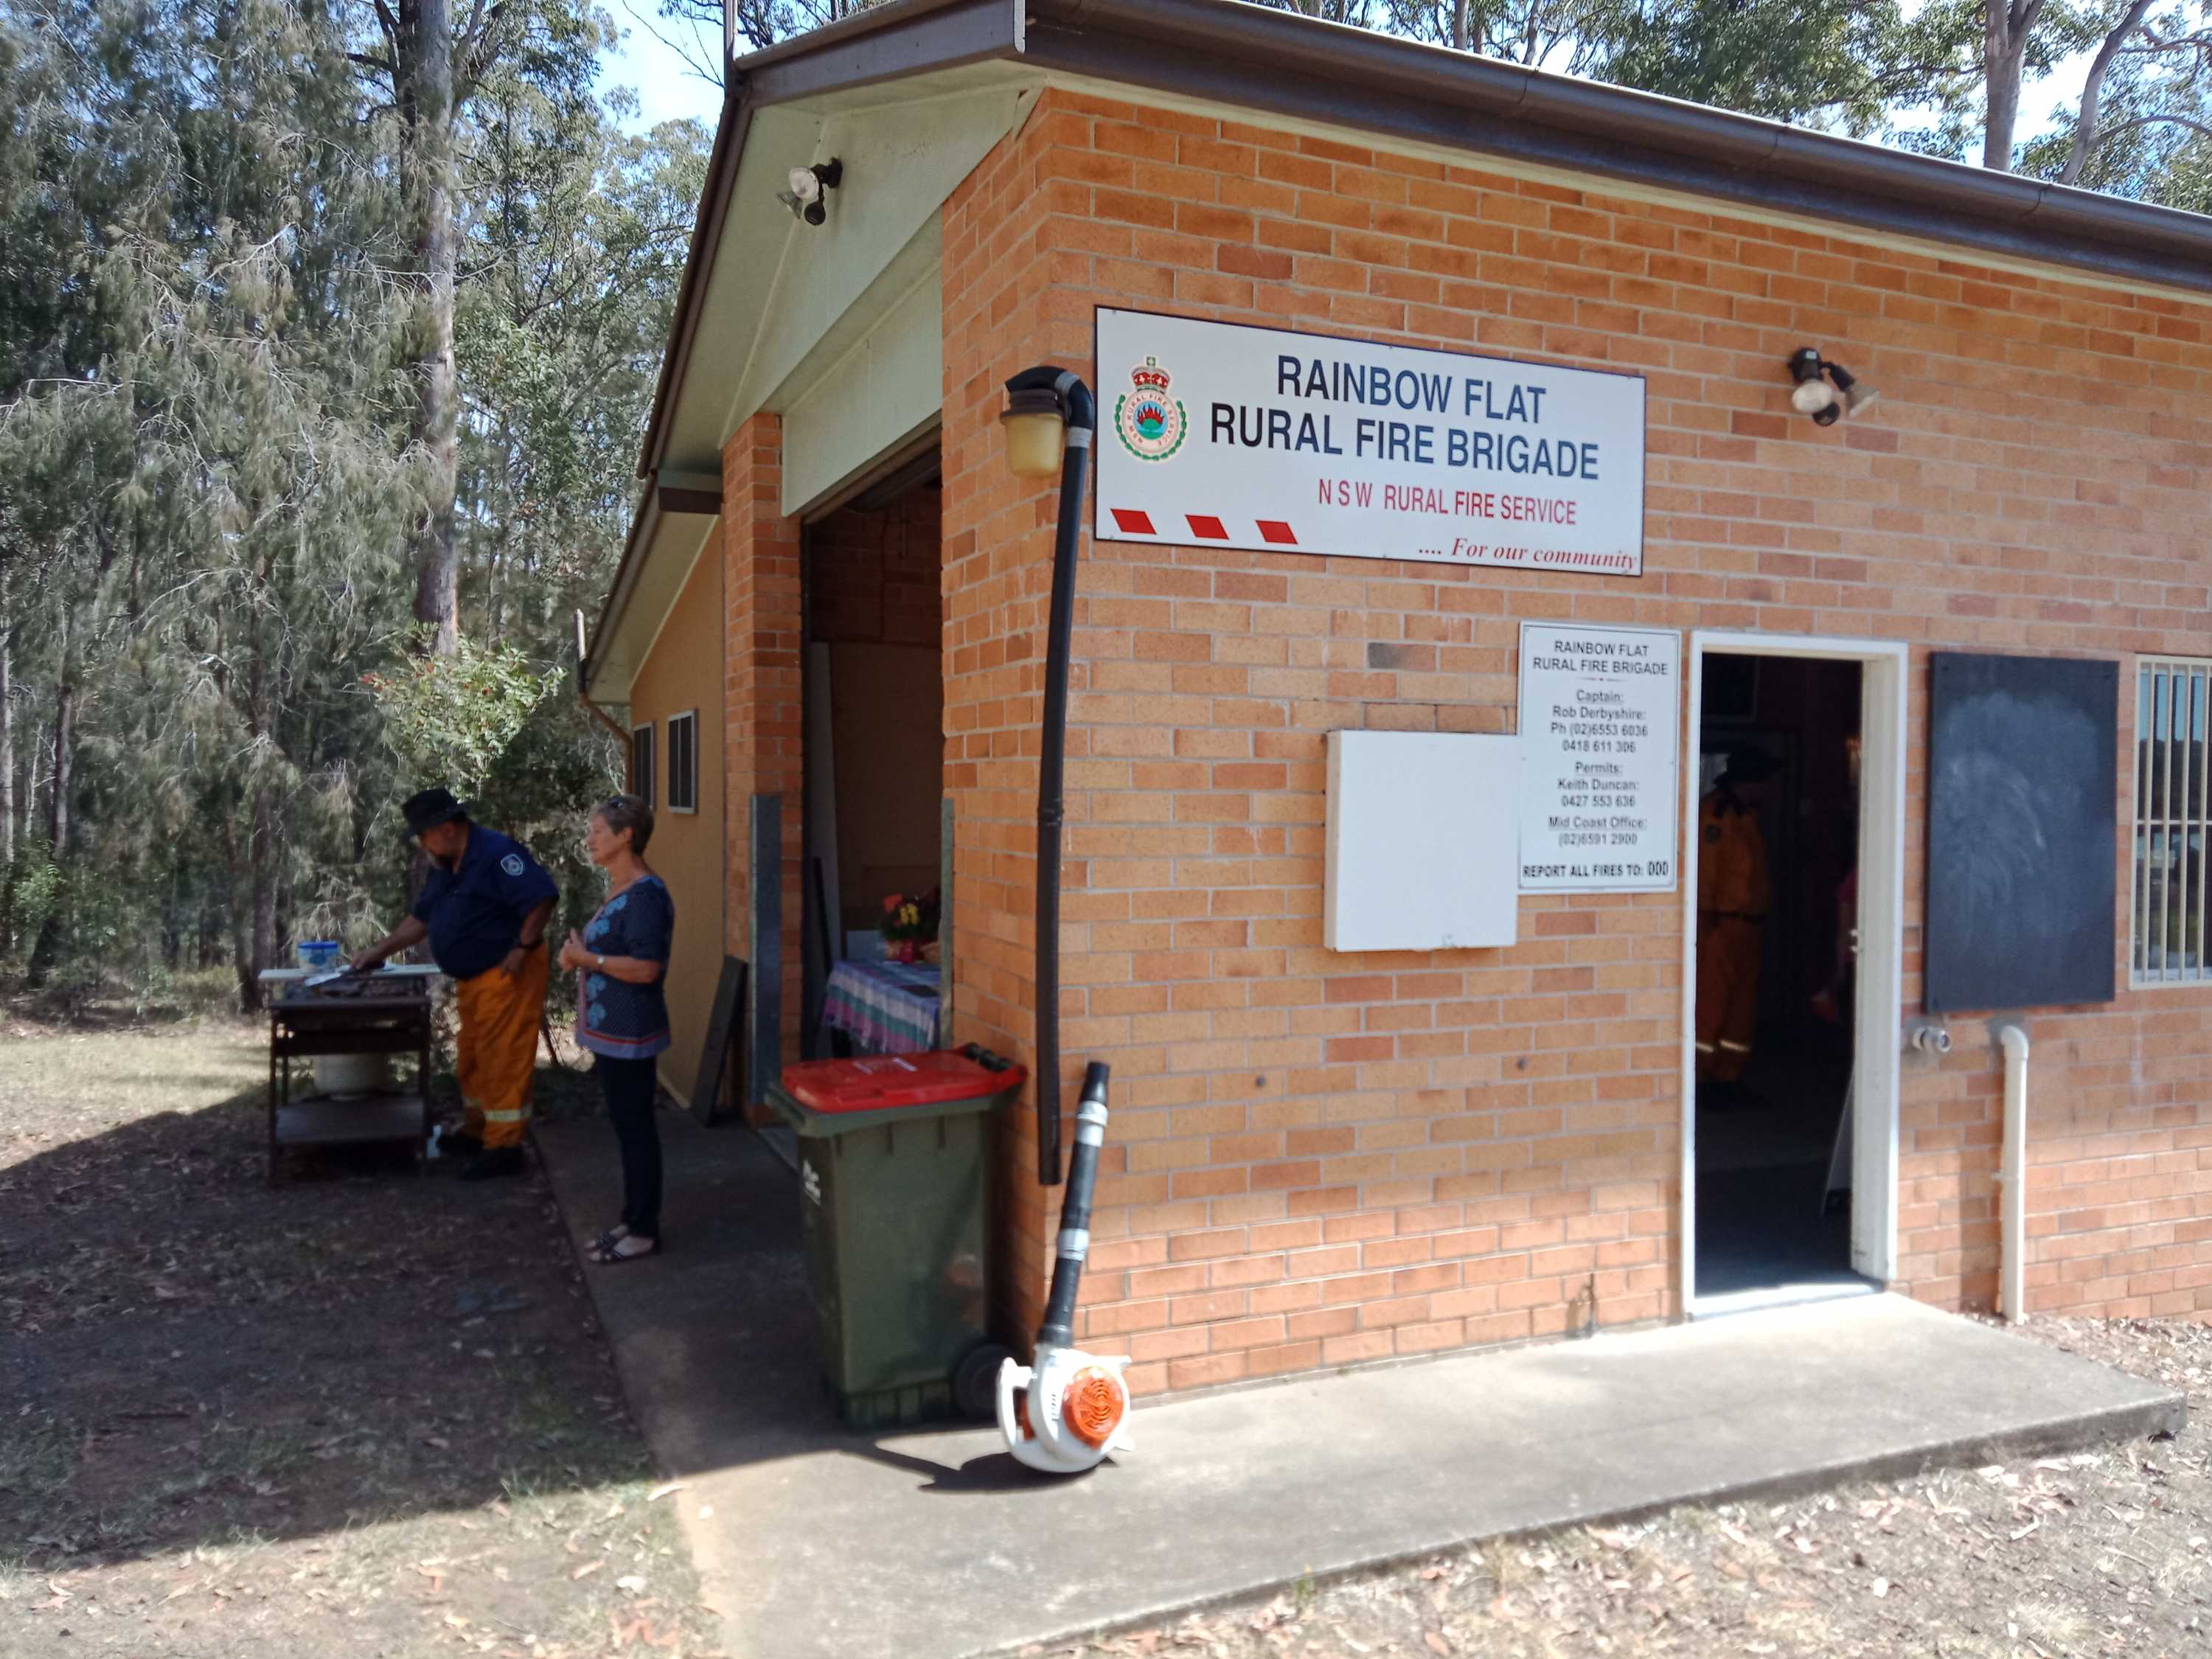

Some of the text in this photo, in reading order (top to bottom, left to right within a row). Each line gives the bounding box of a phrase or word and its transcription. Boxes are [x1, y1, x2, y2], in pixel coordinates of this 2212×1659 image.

[1277, 355, 1547, 424] RAINBOW FLAT
[1211, 402, 1599, 481] RURAL FIRE BRIGADE
[1384, 484, 1448, 515] RURAL
[1455, 491, 1495, 518] FIRE
[1500, 495, 1576, 525] SERVICE
[1451, 538, 1488, 557] For
[1493, 547, 1527, 562] our
[1534, 550, 1637, 571] community
[1554, 640, 1649, 657] RAINBOW FLAT
[1533, 657, 1669, 675] RURAL FIRE BRIGADE
[1552, 706, 1576, 717] Rob
[1551, 722, 1566, 734] Ph
[1557, 779, 1588, 790] Keith
[1548, 816, 1570, 827] Mid
[1573, 816, 1607, 828] Coast
[1523, 865, 1566, 877] REPORT
[1571, 866, 1587, 877] ALL
[1593, 865, 1623, 877] FIRES
